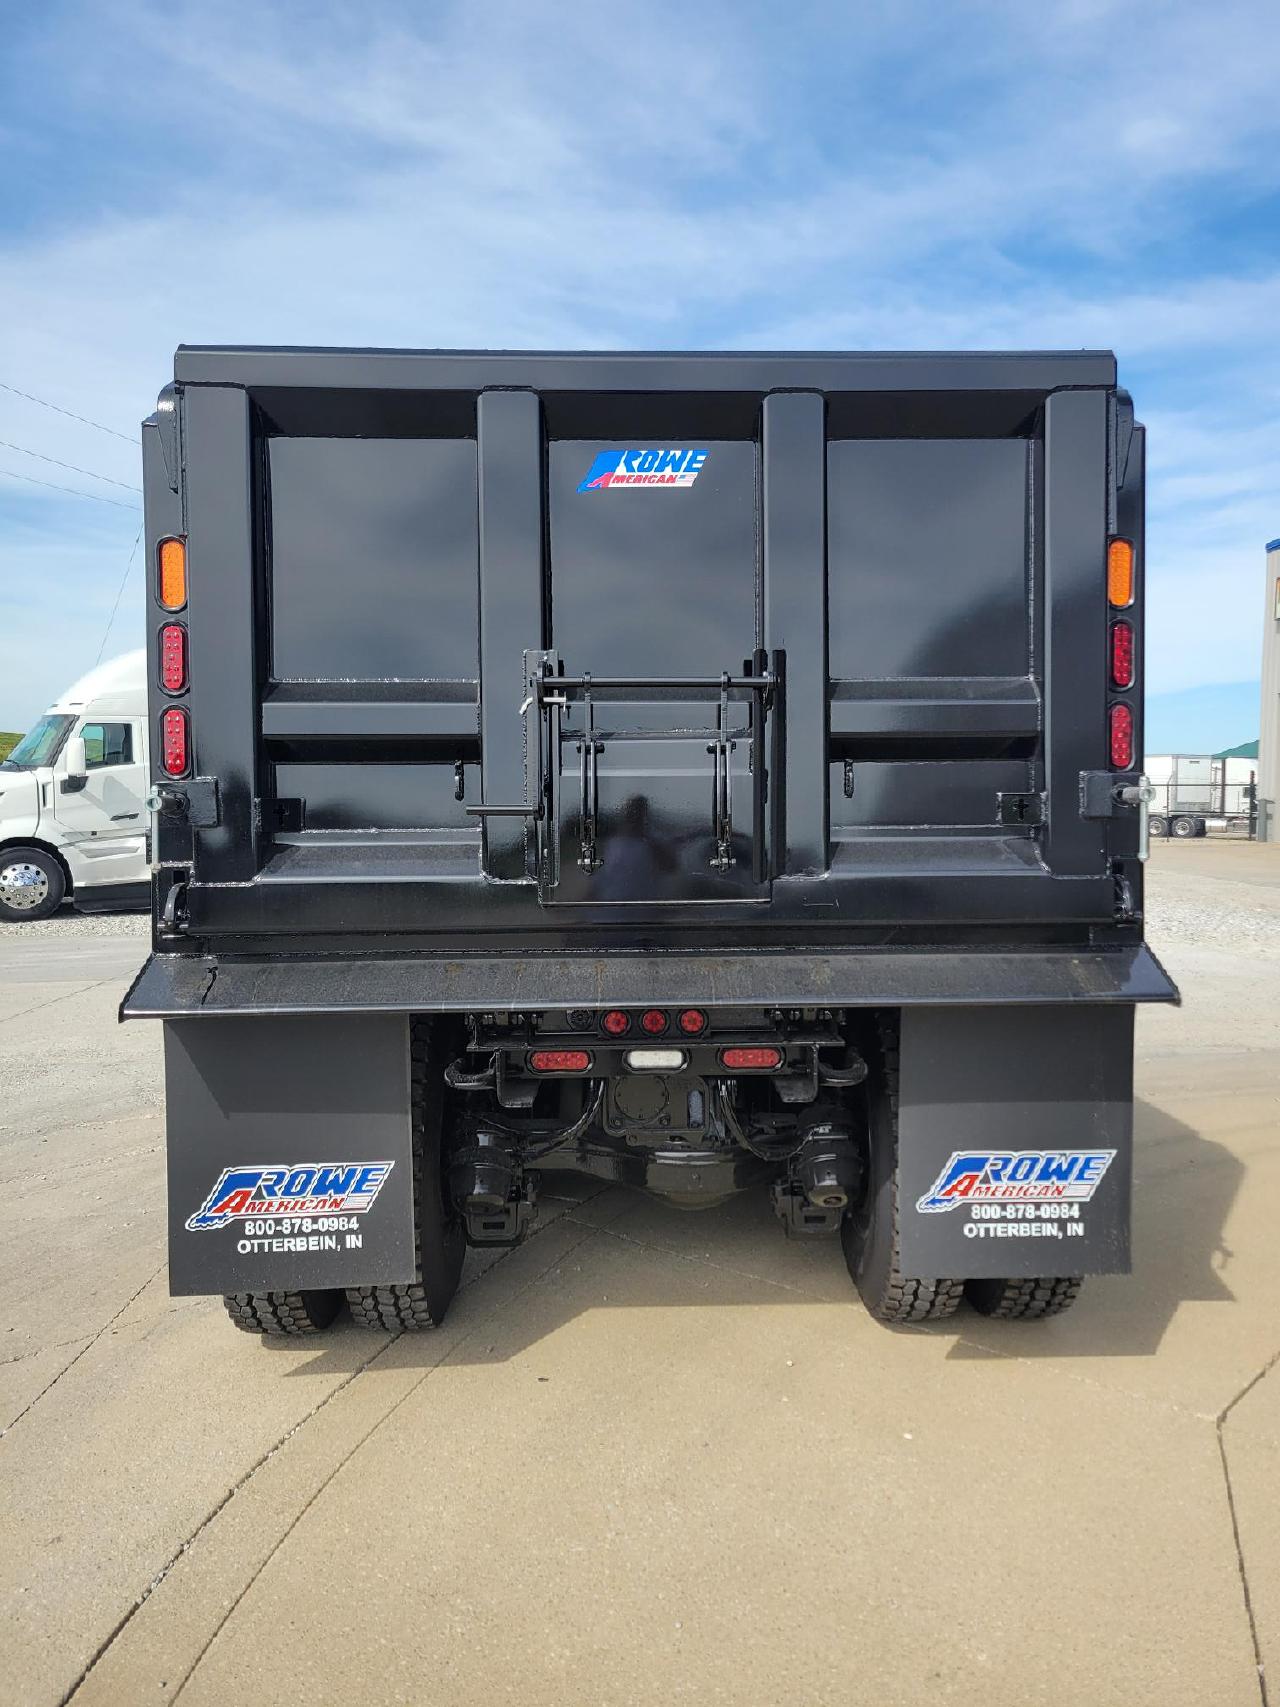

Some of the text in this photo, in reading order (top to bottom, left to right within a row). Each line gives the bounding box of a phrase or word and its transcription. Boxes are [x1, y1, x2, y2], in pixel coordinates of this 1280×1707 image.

[614, 450, 709, 473] ROWE
[586, 472, 679, 488] AMERICAN
[981, 1154, 1107, 1184] ROWE
[254, 1166, 388, 1198] ROWE
[940, 1174, 1068, 1198] AMERICAN
[211, 1189, 346, 1214] AMERICAN
[971, 1203, 1080, 1219] 800-878-0984
[244, 1216, 360, 1236] 800-878-0984
[963, 1222, 1084, 1239] OTTERBEIN, IN
[237, 1234, 363, 1254] OTTERBEIN, IN
